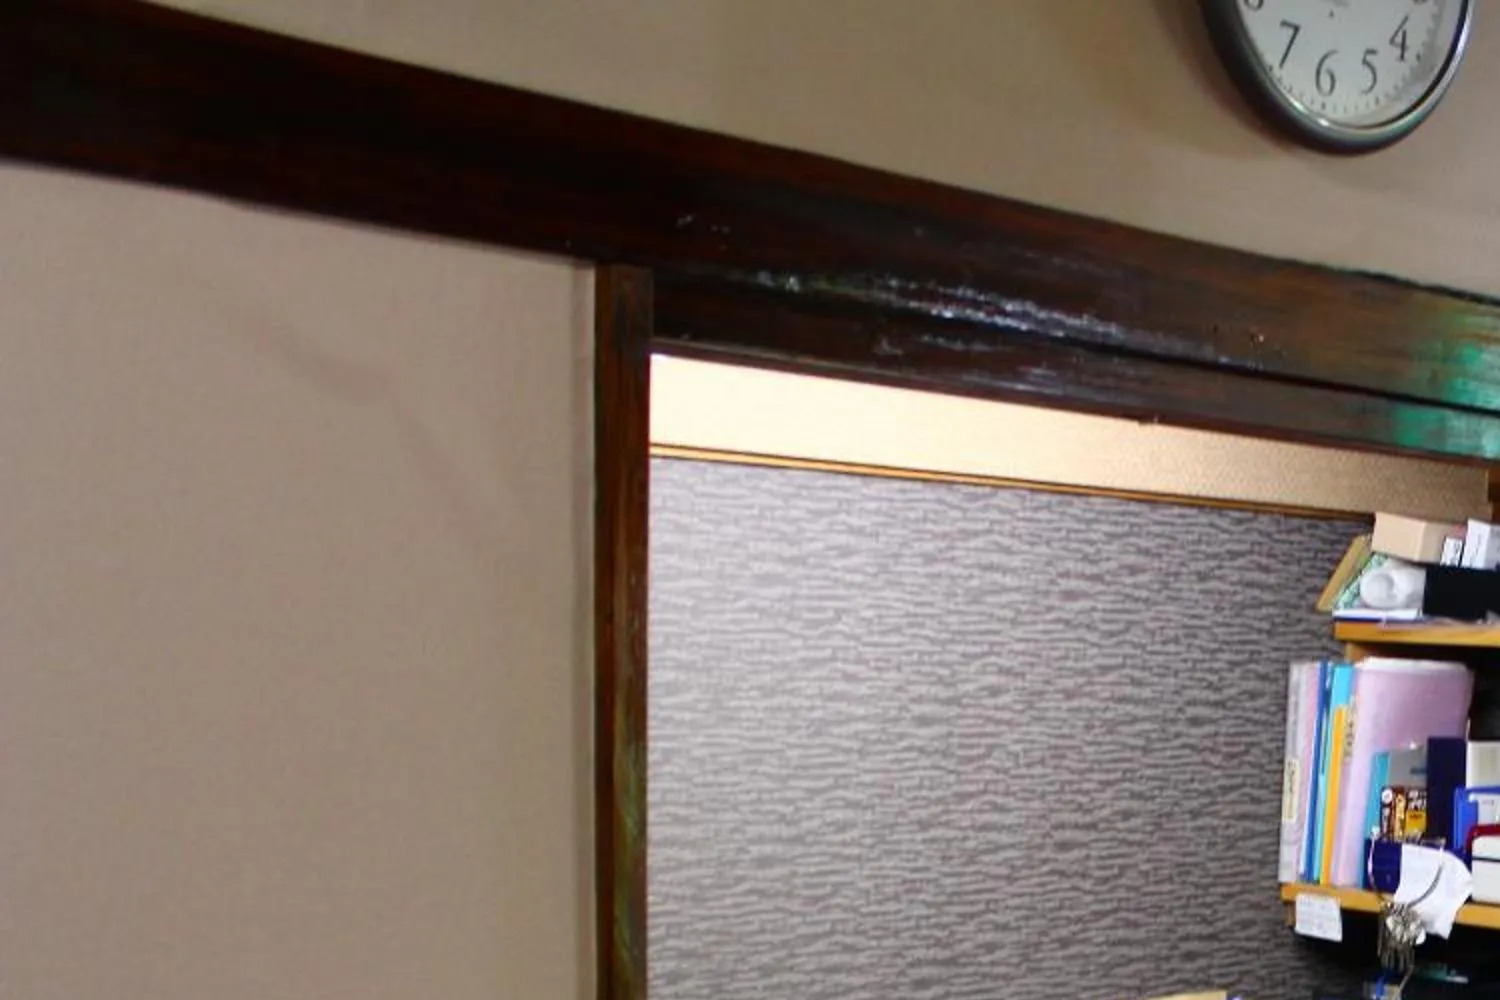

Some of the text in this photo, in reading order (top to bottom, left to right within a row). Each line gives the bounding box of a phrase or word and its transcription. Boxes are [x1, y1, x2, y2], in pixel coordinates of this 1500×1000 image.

[1280, 20, 1300, 68] 7
[1389, 15, 1408, 61] 4
[1315, 50, 1337, 96] 6
[1361, 49, 1378, 94] 5
